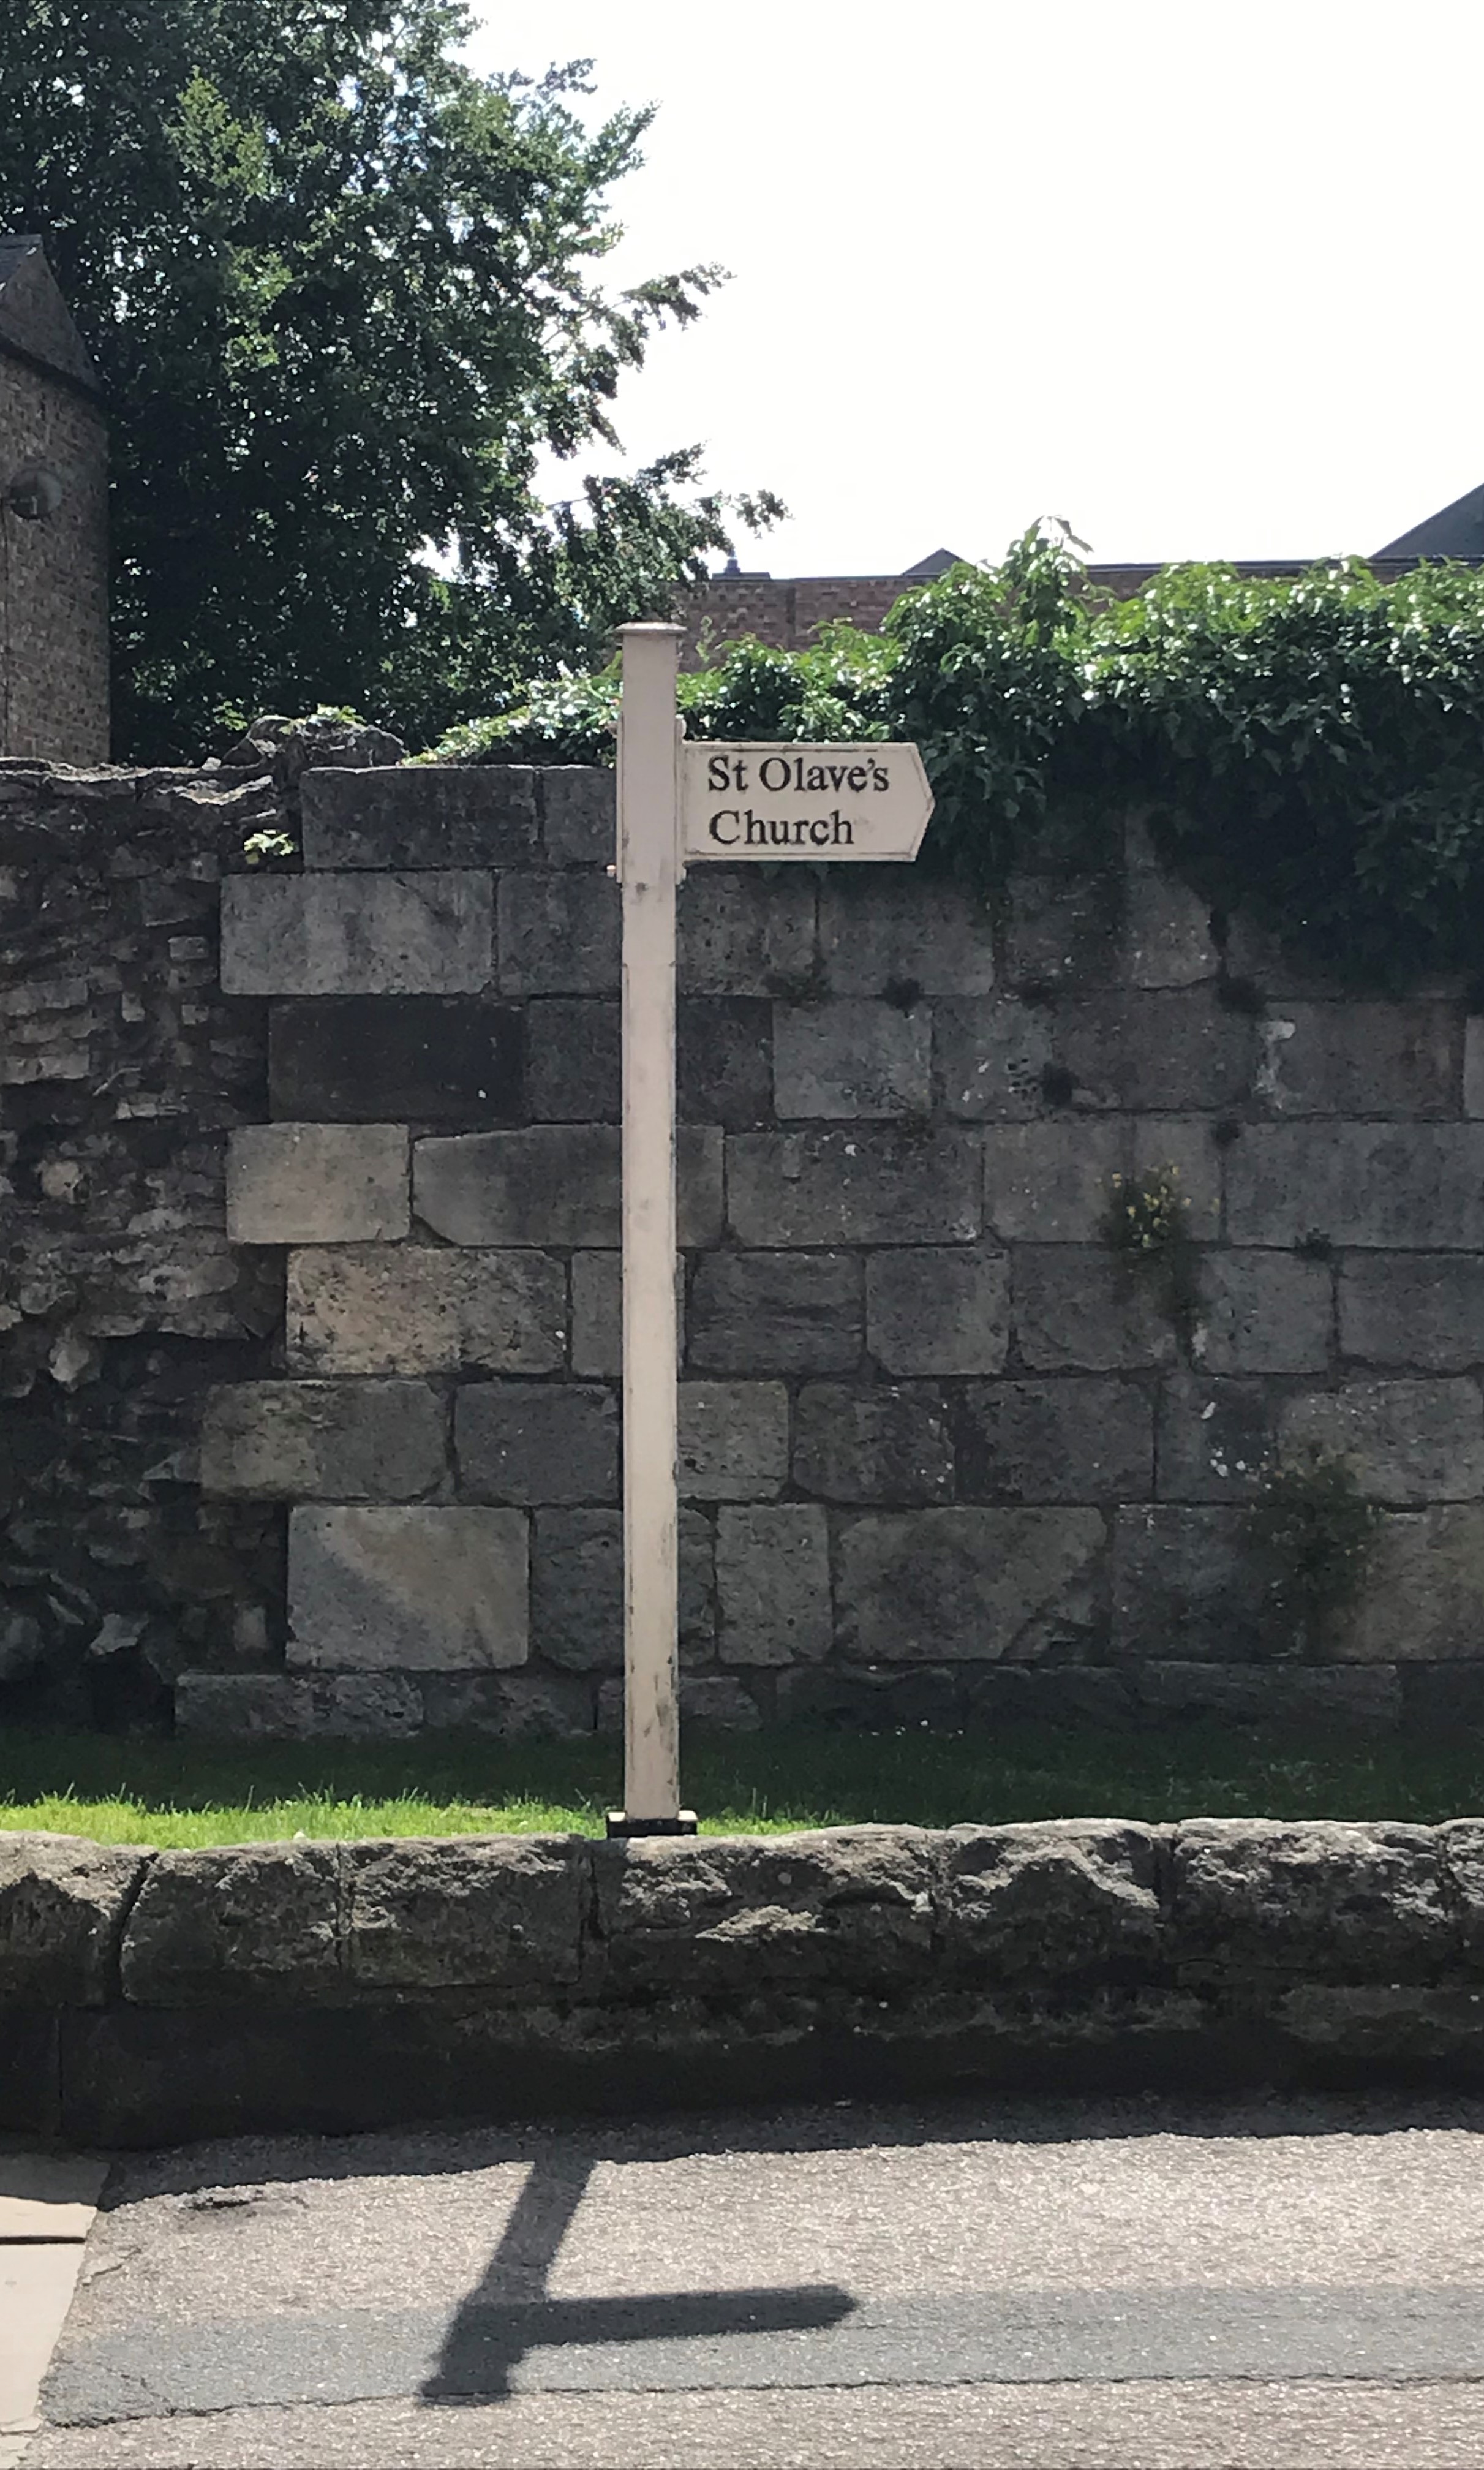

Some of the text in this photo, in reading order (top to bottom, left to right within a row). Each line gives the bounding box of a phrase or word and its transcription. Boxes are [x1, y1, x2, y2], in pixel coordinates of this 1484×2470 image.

[708, 755, 889, 792] St Olave's
[709, 809, 854, 845] Church
